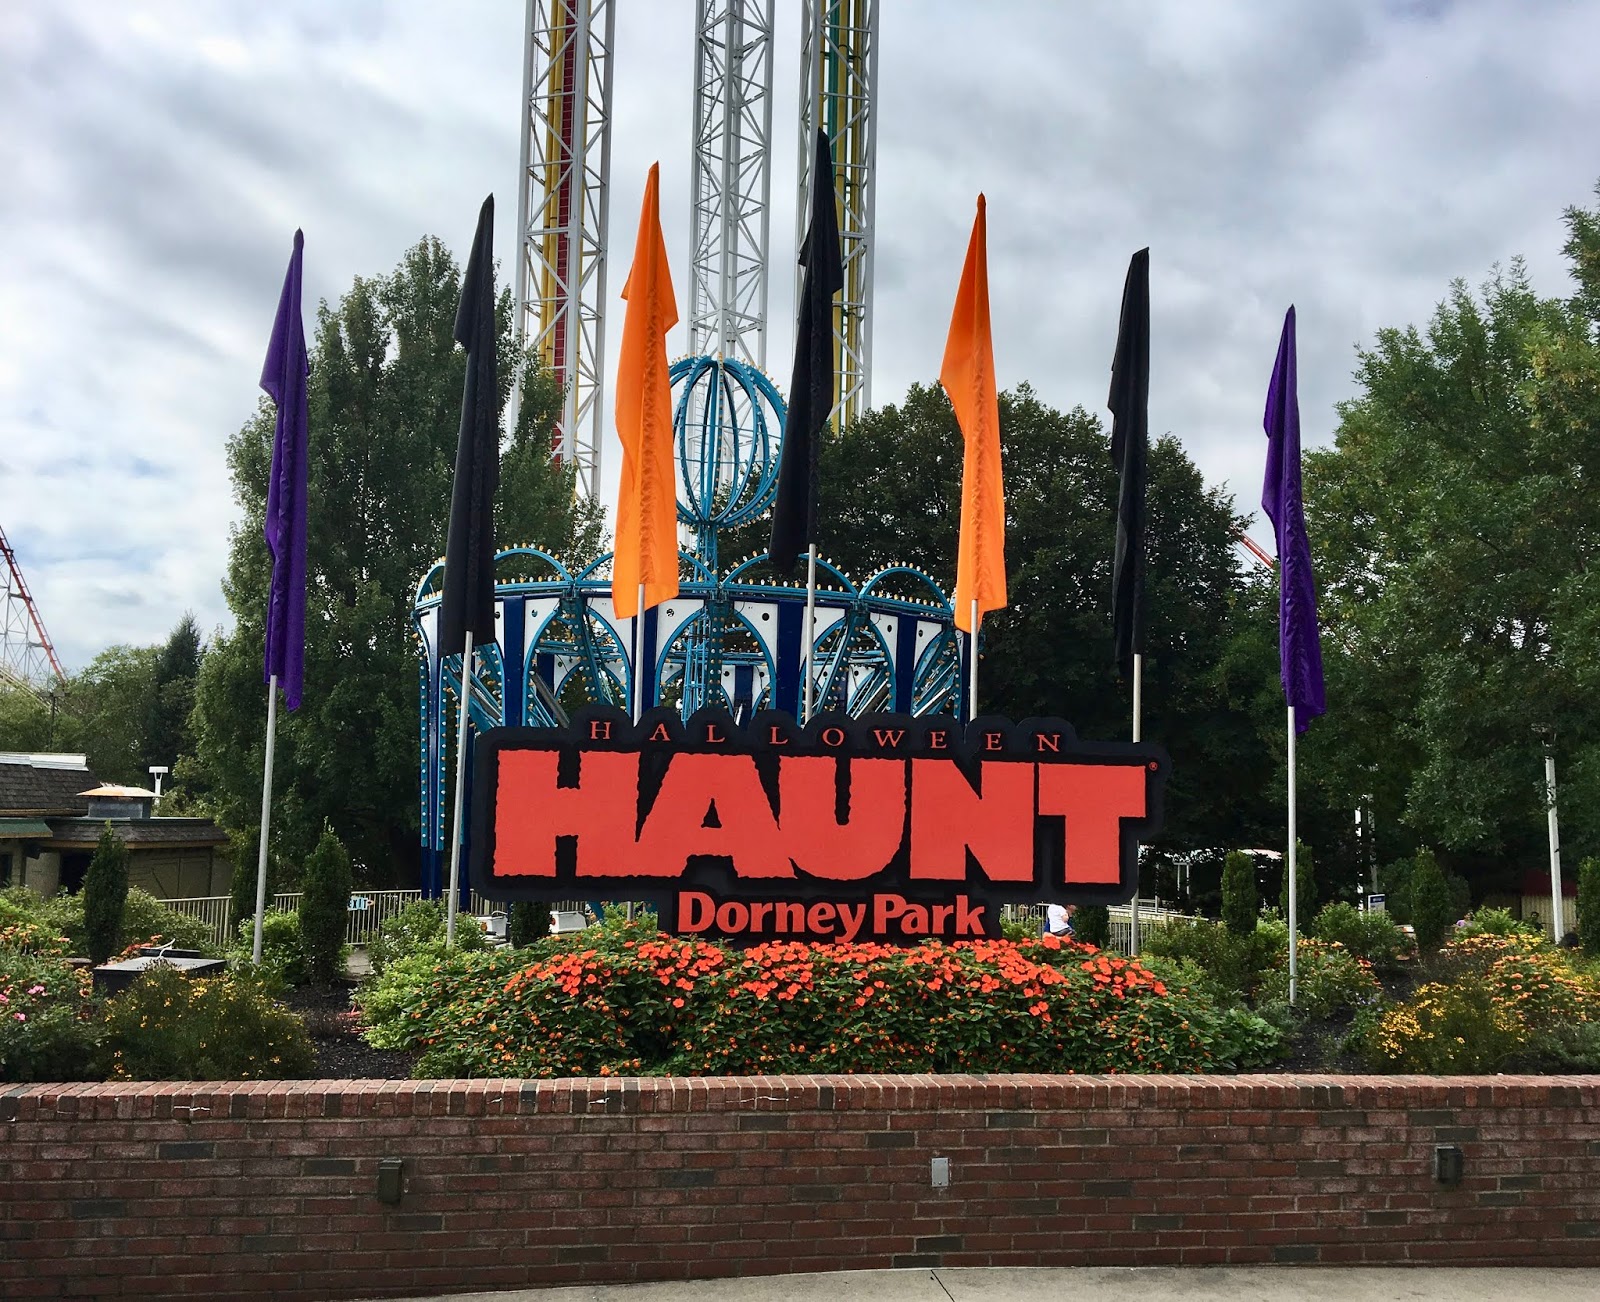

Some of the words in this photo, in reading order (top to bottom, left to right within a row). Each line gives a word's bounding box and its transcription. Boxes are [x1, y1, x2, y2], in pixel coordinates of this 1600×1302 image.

[590, 720, 1061, 752] HALLOWEEN
[494, 748, 1146, 884] HAUNT
[677, 892, 868, 943] Dorney
[872, 894, 986, 936] Park
